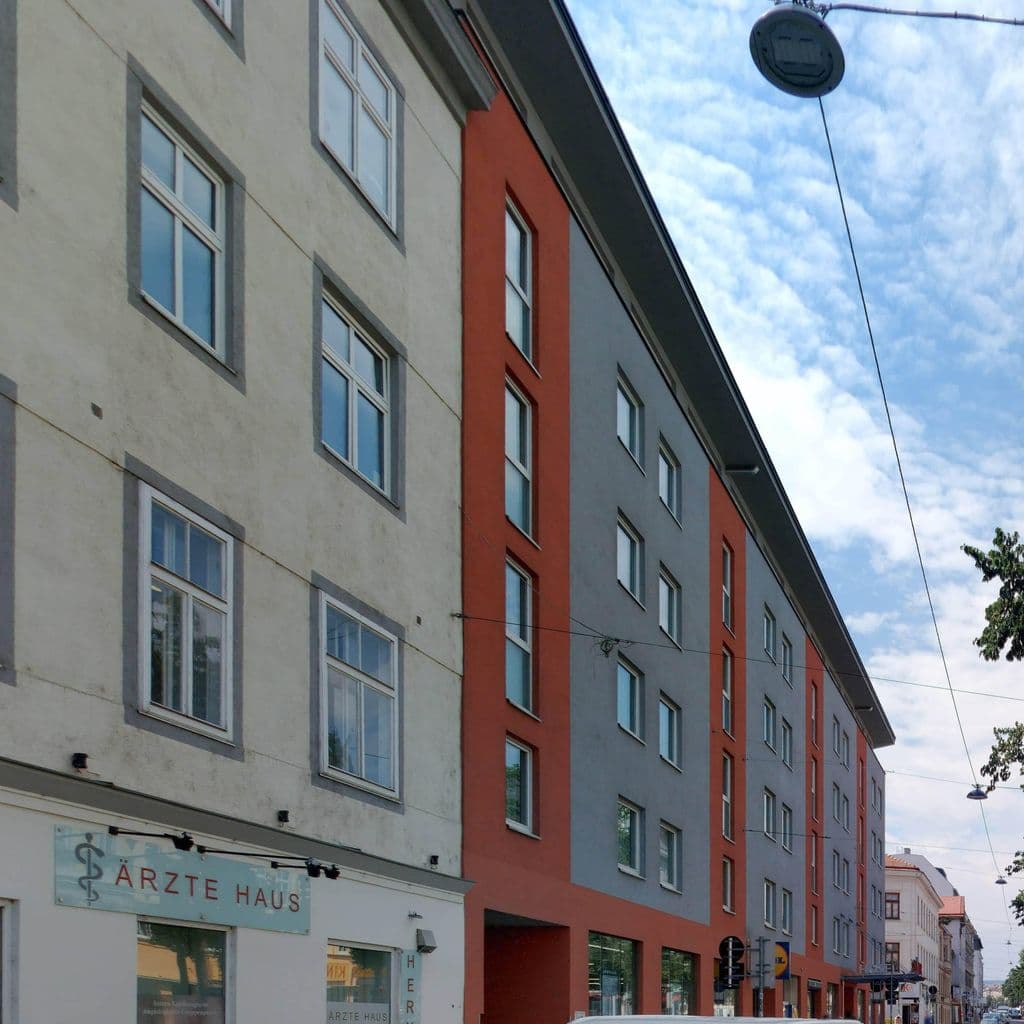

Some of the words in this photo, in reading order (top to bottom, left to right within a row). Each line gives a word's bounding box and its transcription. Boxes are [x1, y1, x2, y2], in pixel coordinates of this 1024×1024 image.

[115, 858, 219, 900] ÄRZTE
[236, 883, 300, 912] HAUS
[364, 1012, 388, 1023] HAUS
